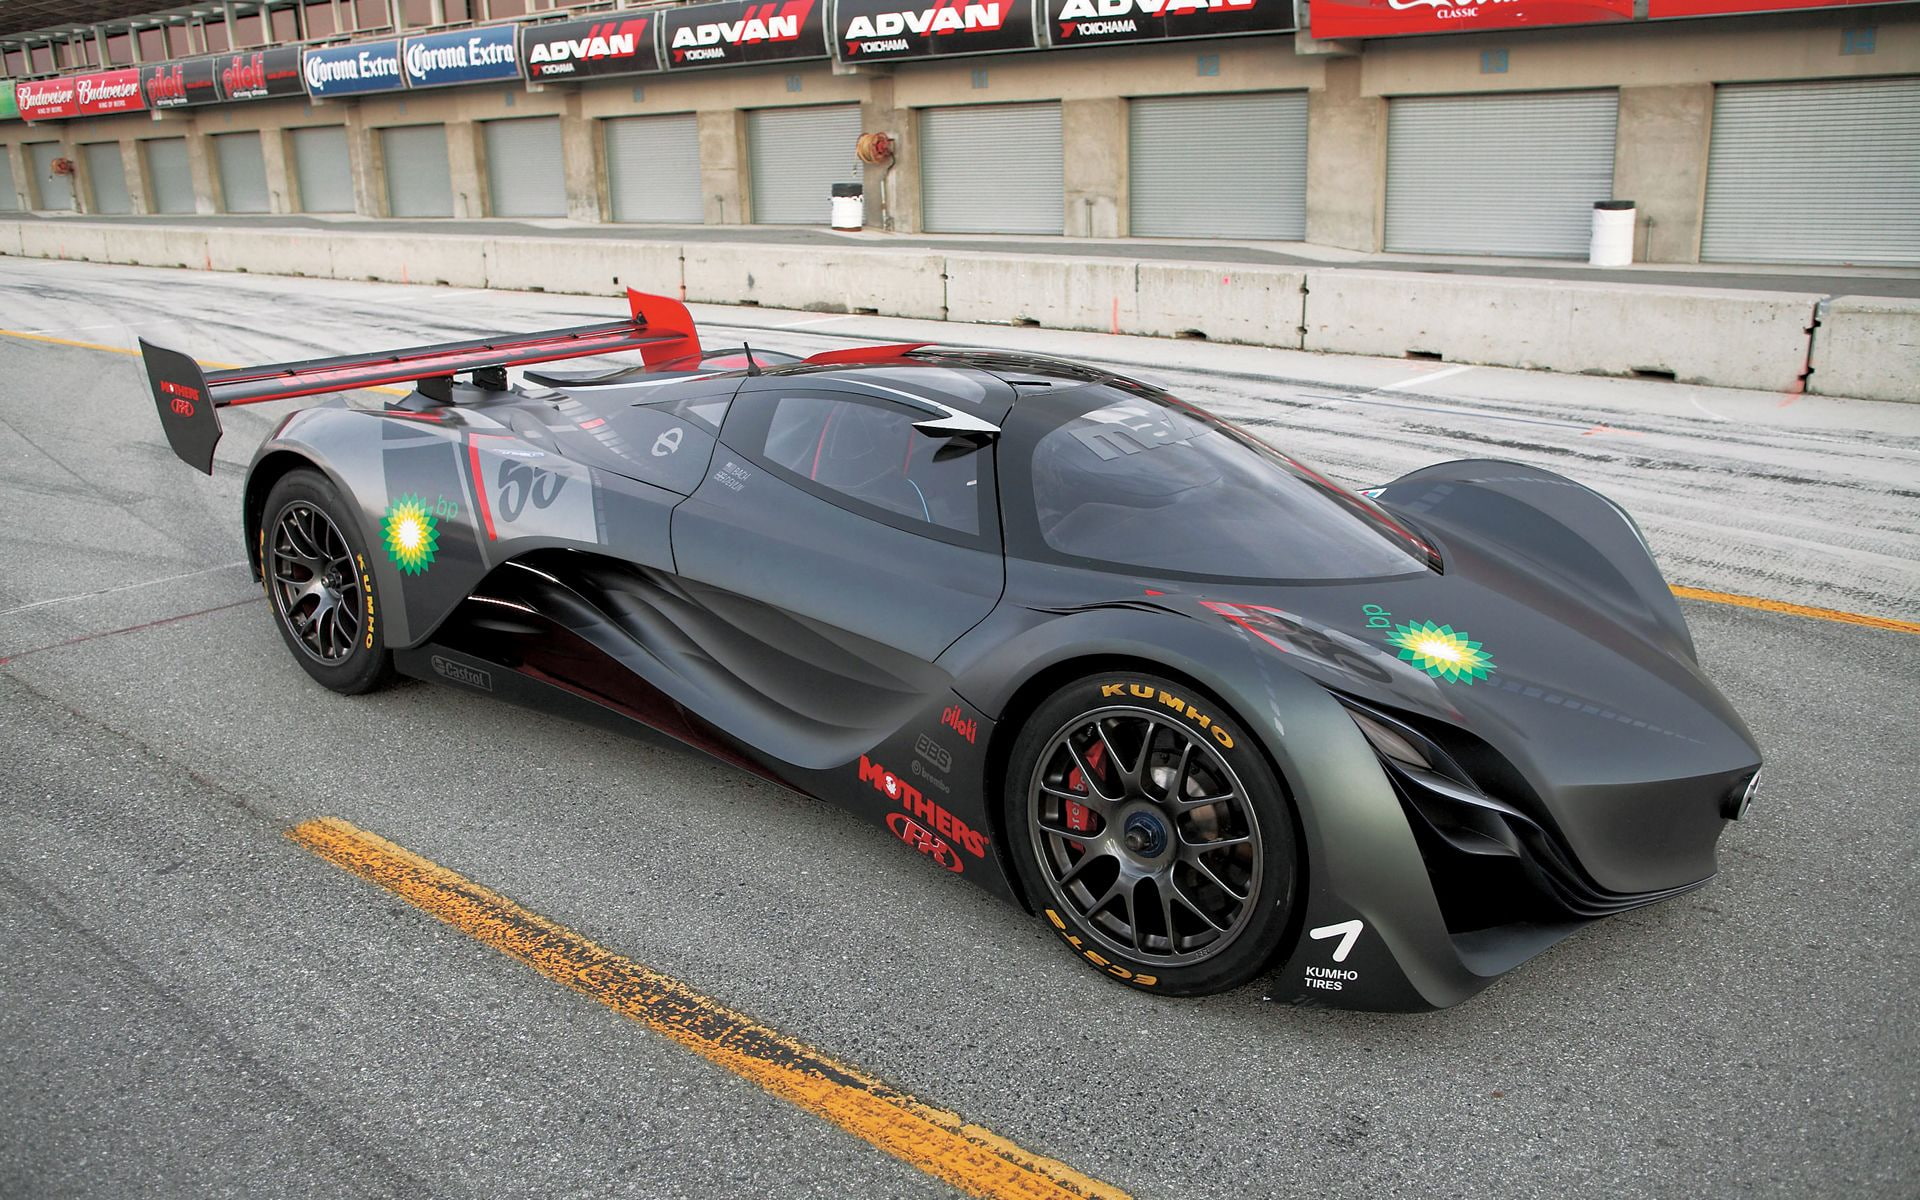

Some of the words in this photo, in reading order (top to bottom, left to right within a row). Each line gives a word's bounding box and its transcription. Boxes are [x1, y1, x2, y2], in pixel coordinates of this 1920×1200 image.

[845, 3, 999, 39] ADVAN
[1437, 7, 1479, 19] CLASSIC
[672, 15, 797, 48] ADVAN
[1076, 19, 1137, 36] YOKOHAMA
[407, 42, 467, 80] Corona
[468, 37, 515, 66] Extra
[530, 33, 634, 64] ADVAN
[684, 47, 725, 61] YOKOHAMA
[860, 39, 909, 53] YOKOHAMA
[306, 56, 359, 91] Corona
[359, 51, 399, 78] Extra
[18, 86, 73, 110] Budweiser
[77, 79, 138, 104] Budweiser
[436, 495, 458, 522] bp
[357, 552, 374, 649] KUMHO
[1362, 603, 1391, 628] bp
[446, 662, 485, 687] Castrol
[941, 704, 977, 744] piloti
[1101, 683, 1234, 749] KUMHO
[915, 733, 952, 773] BBS
[921, 766, 950, 794] brembo
[858, 754, 986, 858] MOTHERS
[1045, 909, 1158, 986] ECSTA
[1304, 977, 1343, 991] TIRES
[1306, 966, 1358, 981] KUMHO
